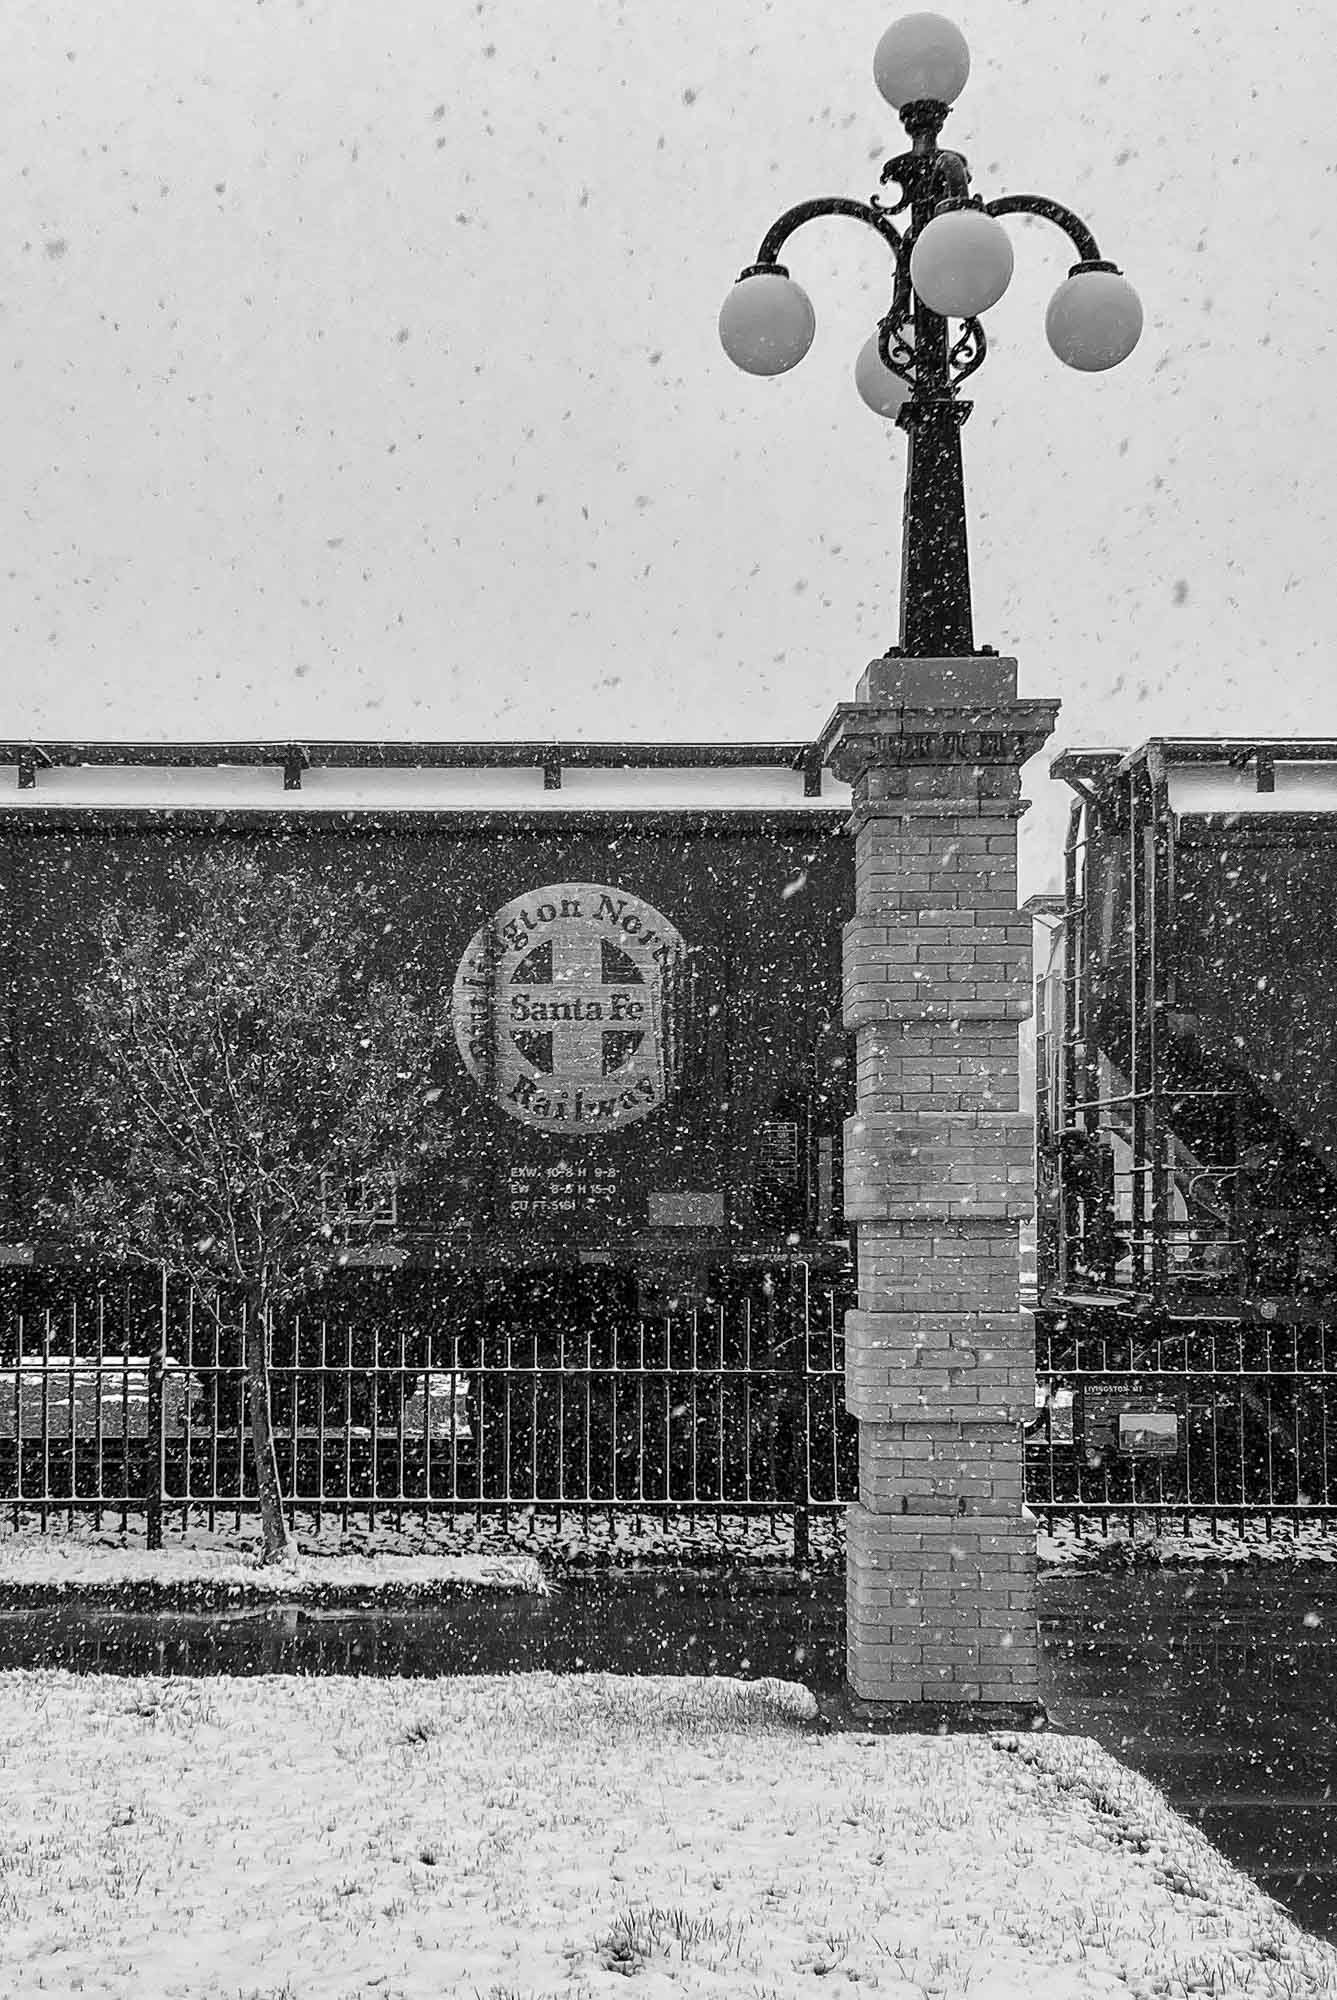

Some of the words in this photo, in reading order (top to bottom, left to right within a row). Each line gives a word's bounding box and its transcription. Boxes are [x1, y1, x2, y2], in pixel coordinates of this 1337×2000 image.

[511, 993, 603, 1022] Santa
[609, 993, 644, 1022] Fe
[578, 1167, 587, 1177] H
[578, 1184, 587, 1194] H
